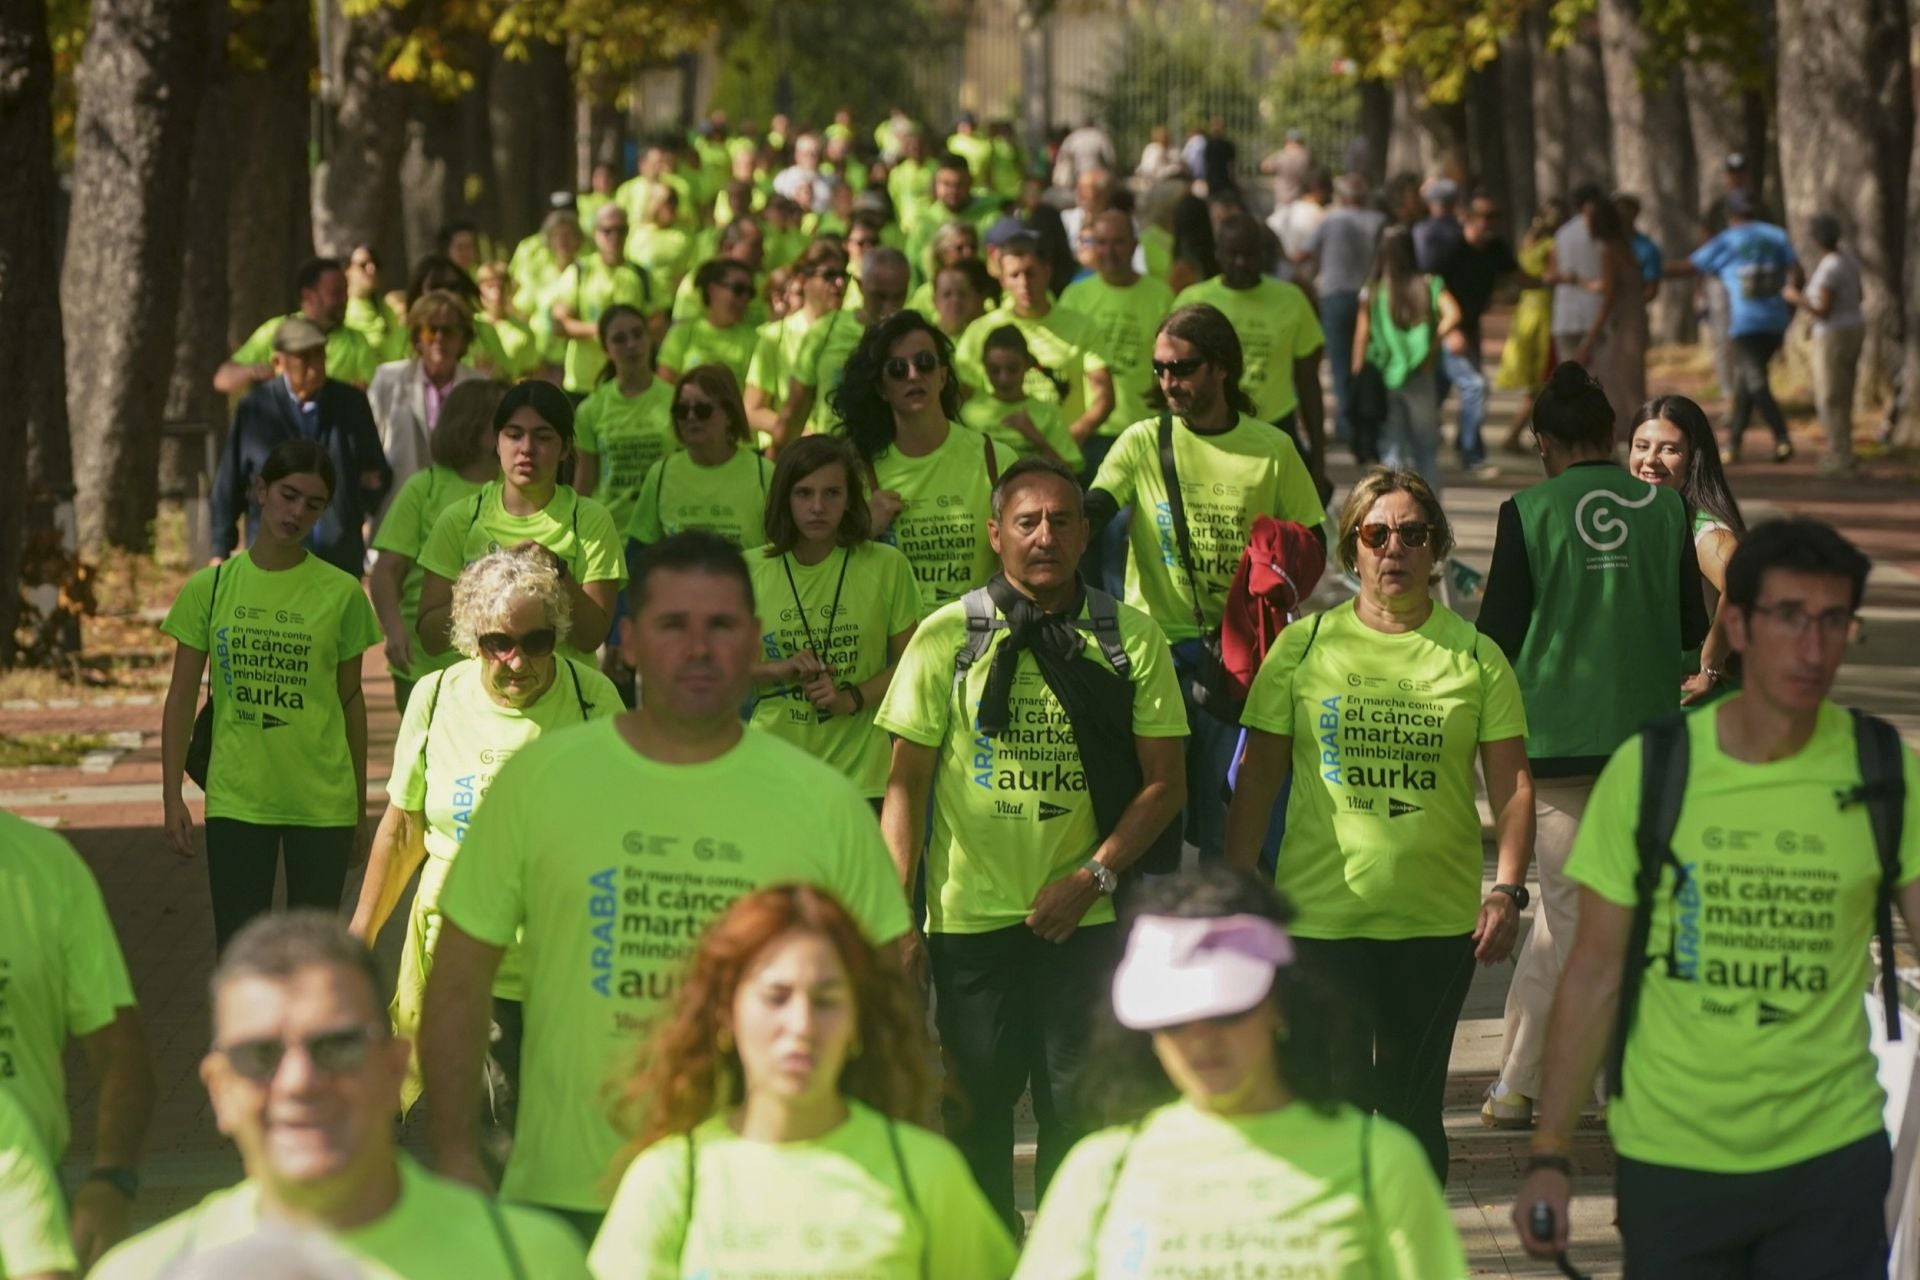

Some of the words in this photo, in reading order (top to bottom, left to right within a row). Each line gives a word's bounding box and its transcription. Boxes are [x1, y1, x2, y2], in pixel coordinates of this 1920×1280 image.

[1187, 501, 1218, 511] marcha
[1193, 510, 1247, 526] cáncer
[900, 524, 916, 538] el
[921, 521, 976, 537] cáncer
[1188, 525, 1246, 543] artxan
[902, 536, 976, 552] martxan
[231, 626, 244, 634] En
[245, 627, 281, 638] marcha
[282, 630, 312, 641] contra
[780, 629, 793, 638] En
[231, 634, 247, 649] el
[251, 637, 312, 656] cáncer
[782, 637, 800, 652] el
[232, 652, 309, 672] martxan
[233, 667, 307, 687] minbiziaren
[236, 684, 304, 710] aurka
[1347, 695, 1360, 705] En
[1363, 695, 1405, 709] marcha
[1408, 700, 1444, 712] contra
[1025, 706, 1072, 725] cánc
[1345, 706, 1365, 722] el
[1371, 709, 1444, 728] cáncer
[1000, 725, 1076, 745] martxa
[1319, 694, 1343, 785] ARABA
[1344, 725, 1443, 749] martxan
[998, 747, 1080, 762] minbiziare
[1345, 744, 1441, 764] minbiziaren
[997, 764, 1087, 791] aurka
[1347, 763, 1437, 791] aurka
[995, 800, 1024, 815] Vital
[1346, 795, 1375, 811] Vital
[623, 865, 642, 879] En
[648, 868, 702, 885] marcha
[623, 884, 649, 906] el
[1704, 876, 1730, 899] el
[1738, 877, 1838, 904] cáncer
[1705, 904, 1836, 930] martxan
[588, 866, 617, 998] ARABA
[1704, 931, 1834, 953] minbiziaren
[1705, 954, 1831, 993] aurka
